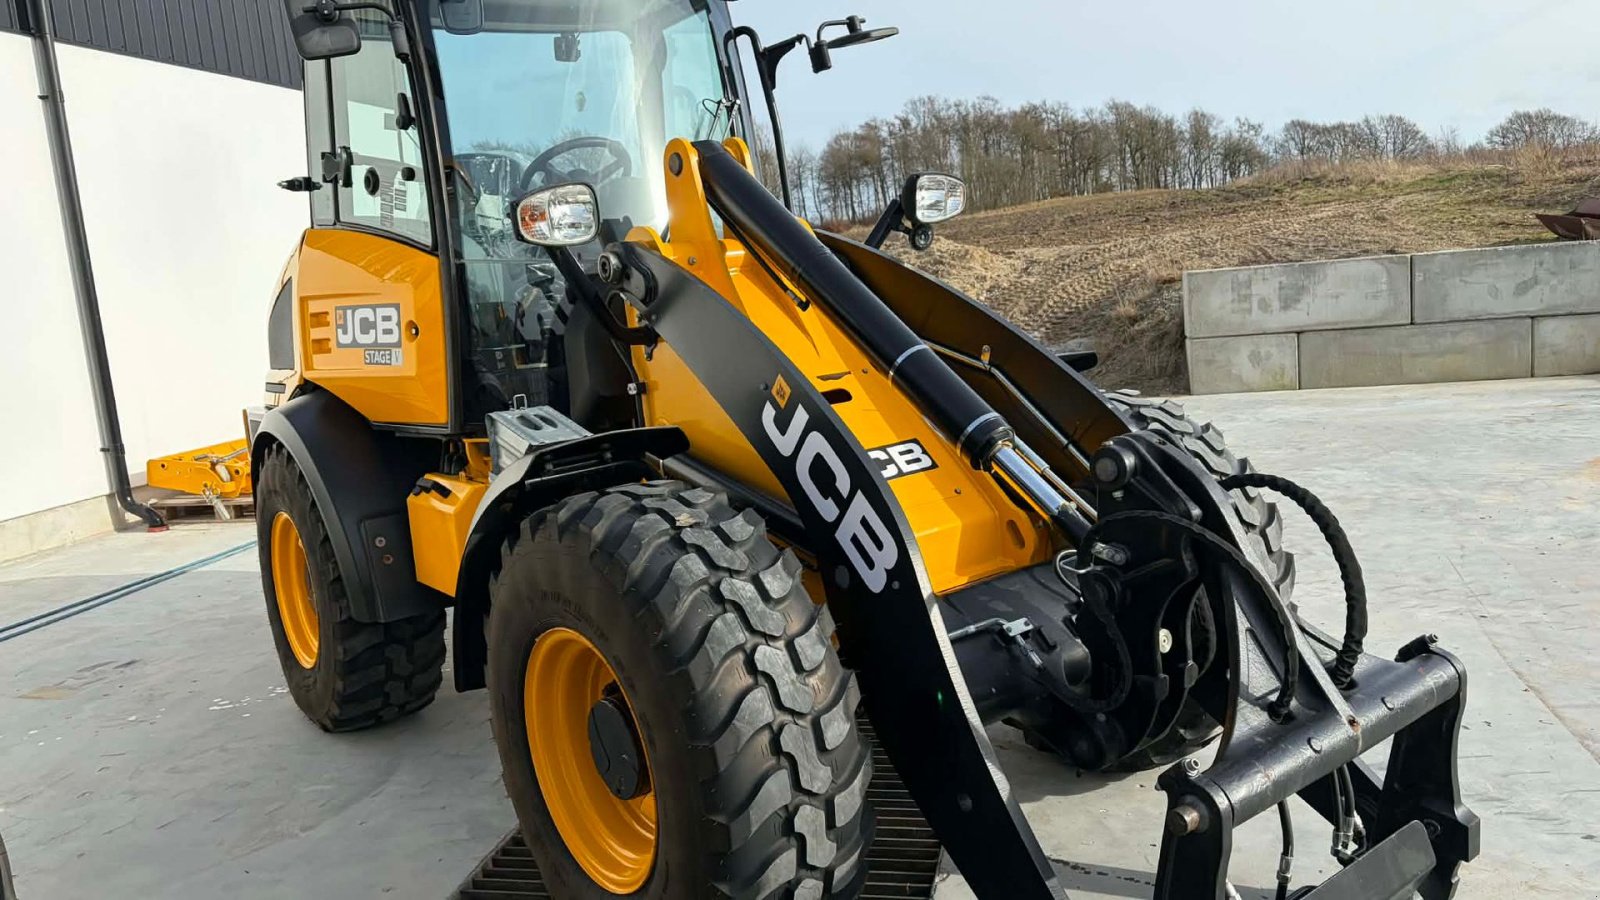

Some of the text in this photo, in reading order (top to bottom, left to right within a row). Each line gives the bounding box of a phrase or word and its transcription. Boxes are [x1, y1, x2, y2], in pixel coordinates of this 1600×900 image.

[337, 307, 399, 344] JCB
[364, 350, 391, 365] STAGE
[867, 442, 932, 478] CB
[762, 400, 898, 594] JCB
